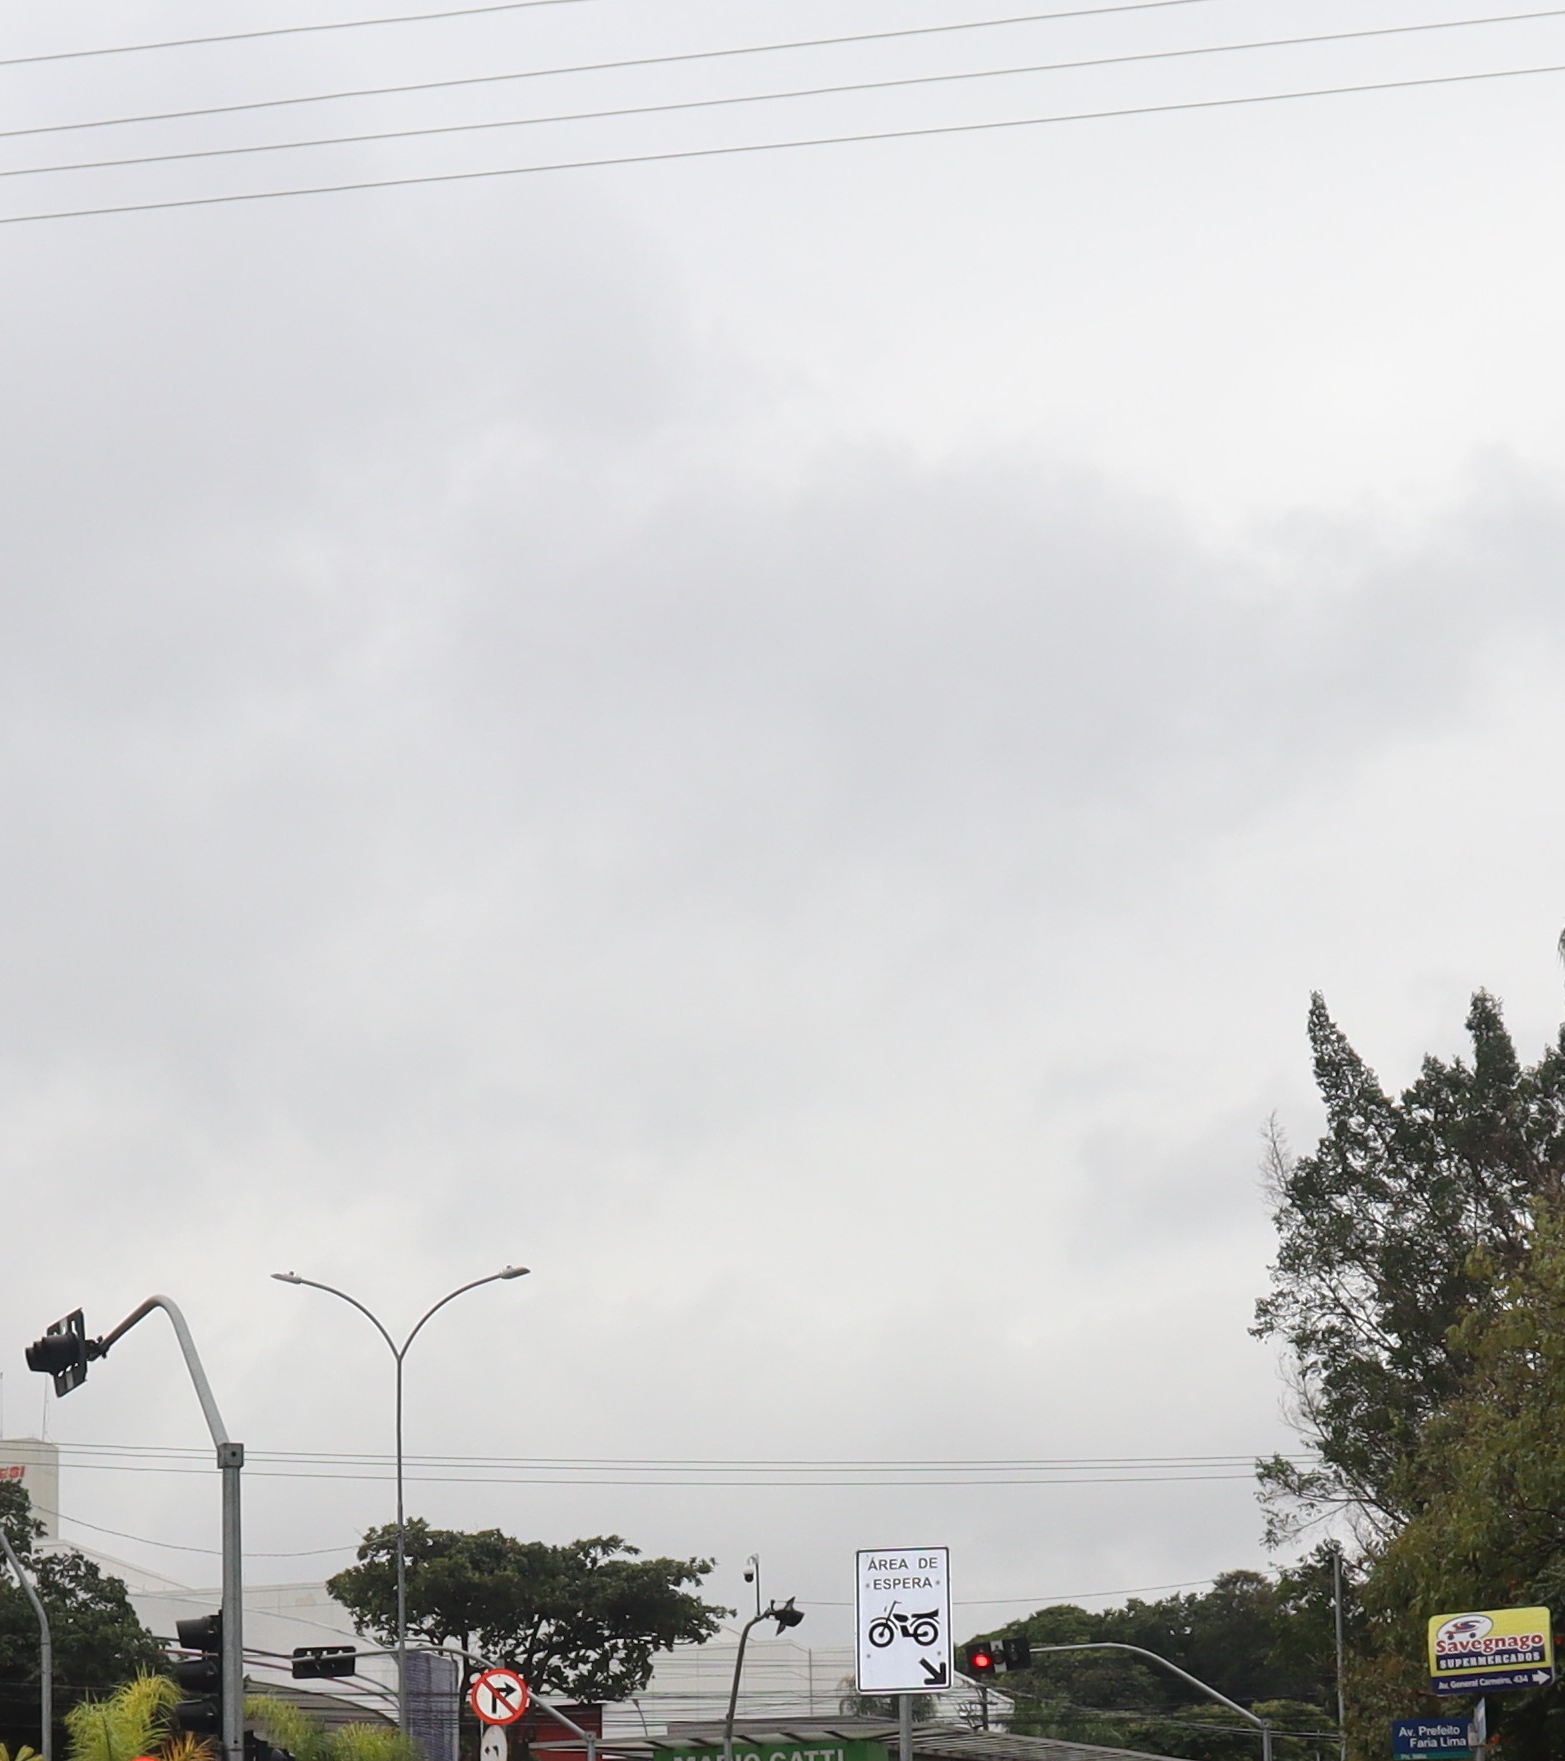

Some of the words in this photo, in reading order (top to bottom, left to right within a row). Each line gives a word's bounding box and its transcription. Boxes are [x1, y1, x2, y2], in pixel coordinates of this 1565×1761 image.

[868, 1557, 909, 1571] ÁREA
[918, 1557, 938, 1569] DE
[873, 1577, 933, 1590] ESPERA
[1436, 1633, 1544, 1655] Savegnago
[1439, 1652, 1541, 1669] SUPERMERCADOS
[1398, 1726, 1415, 1737] Av.
[1418, 1724, 1461, 1736] Prefeito
[1409, 1737, 1437, 1748] Faria
[1440, 1736, 1466, 1747] Lima
